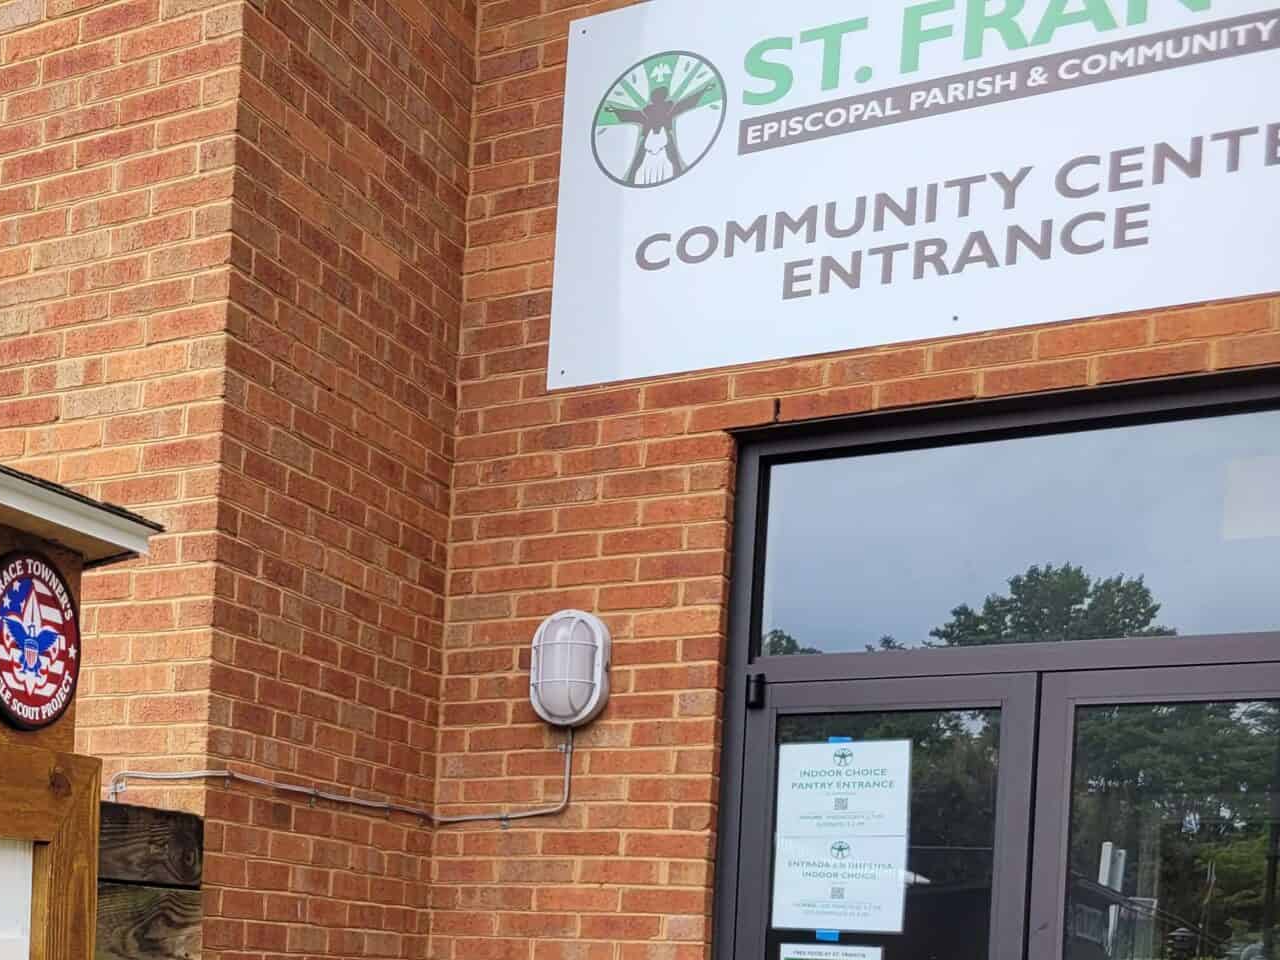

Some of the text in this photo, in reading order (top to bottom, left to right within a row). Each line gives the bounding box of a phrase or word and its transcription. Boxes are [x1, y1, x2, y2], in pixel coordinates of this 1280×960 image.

[742, 16, 872, 106] ST.
[746, 19, 1280, 146] EPISCOPAL PARISH & COMMUNITY
[634, 166, 1033, 272] COMMUNITY
[781, 203, 1151, 300] ENTRANCE
[26, 558, 73, 622] TOWNER'S
[11, 698, 40, 721] SCOUT
[41, 670, 73, 720] PROJECT
[792, 780, 895, 790] PANTRY ENTRANCE
[845, 768, 888, 777] CHOICE
